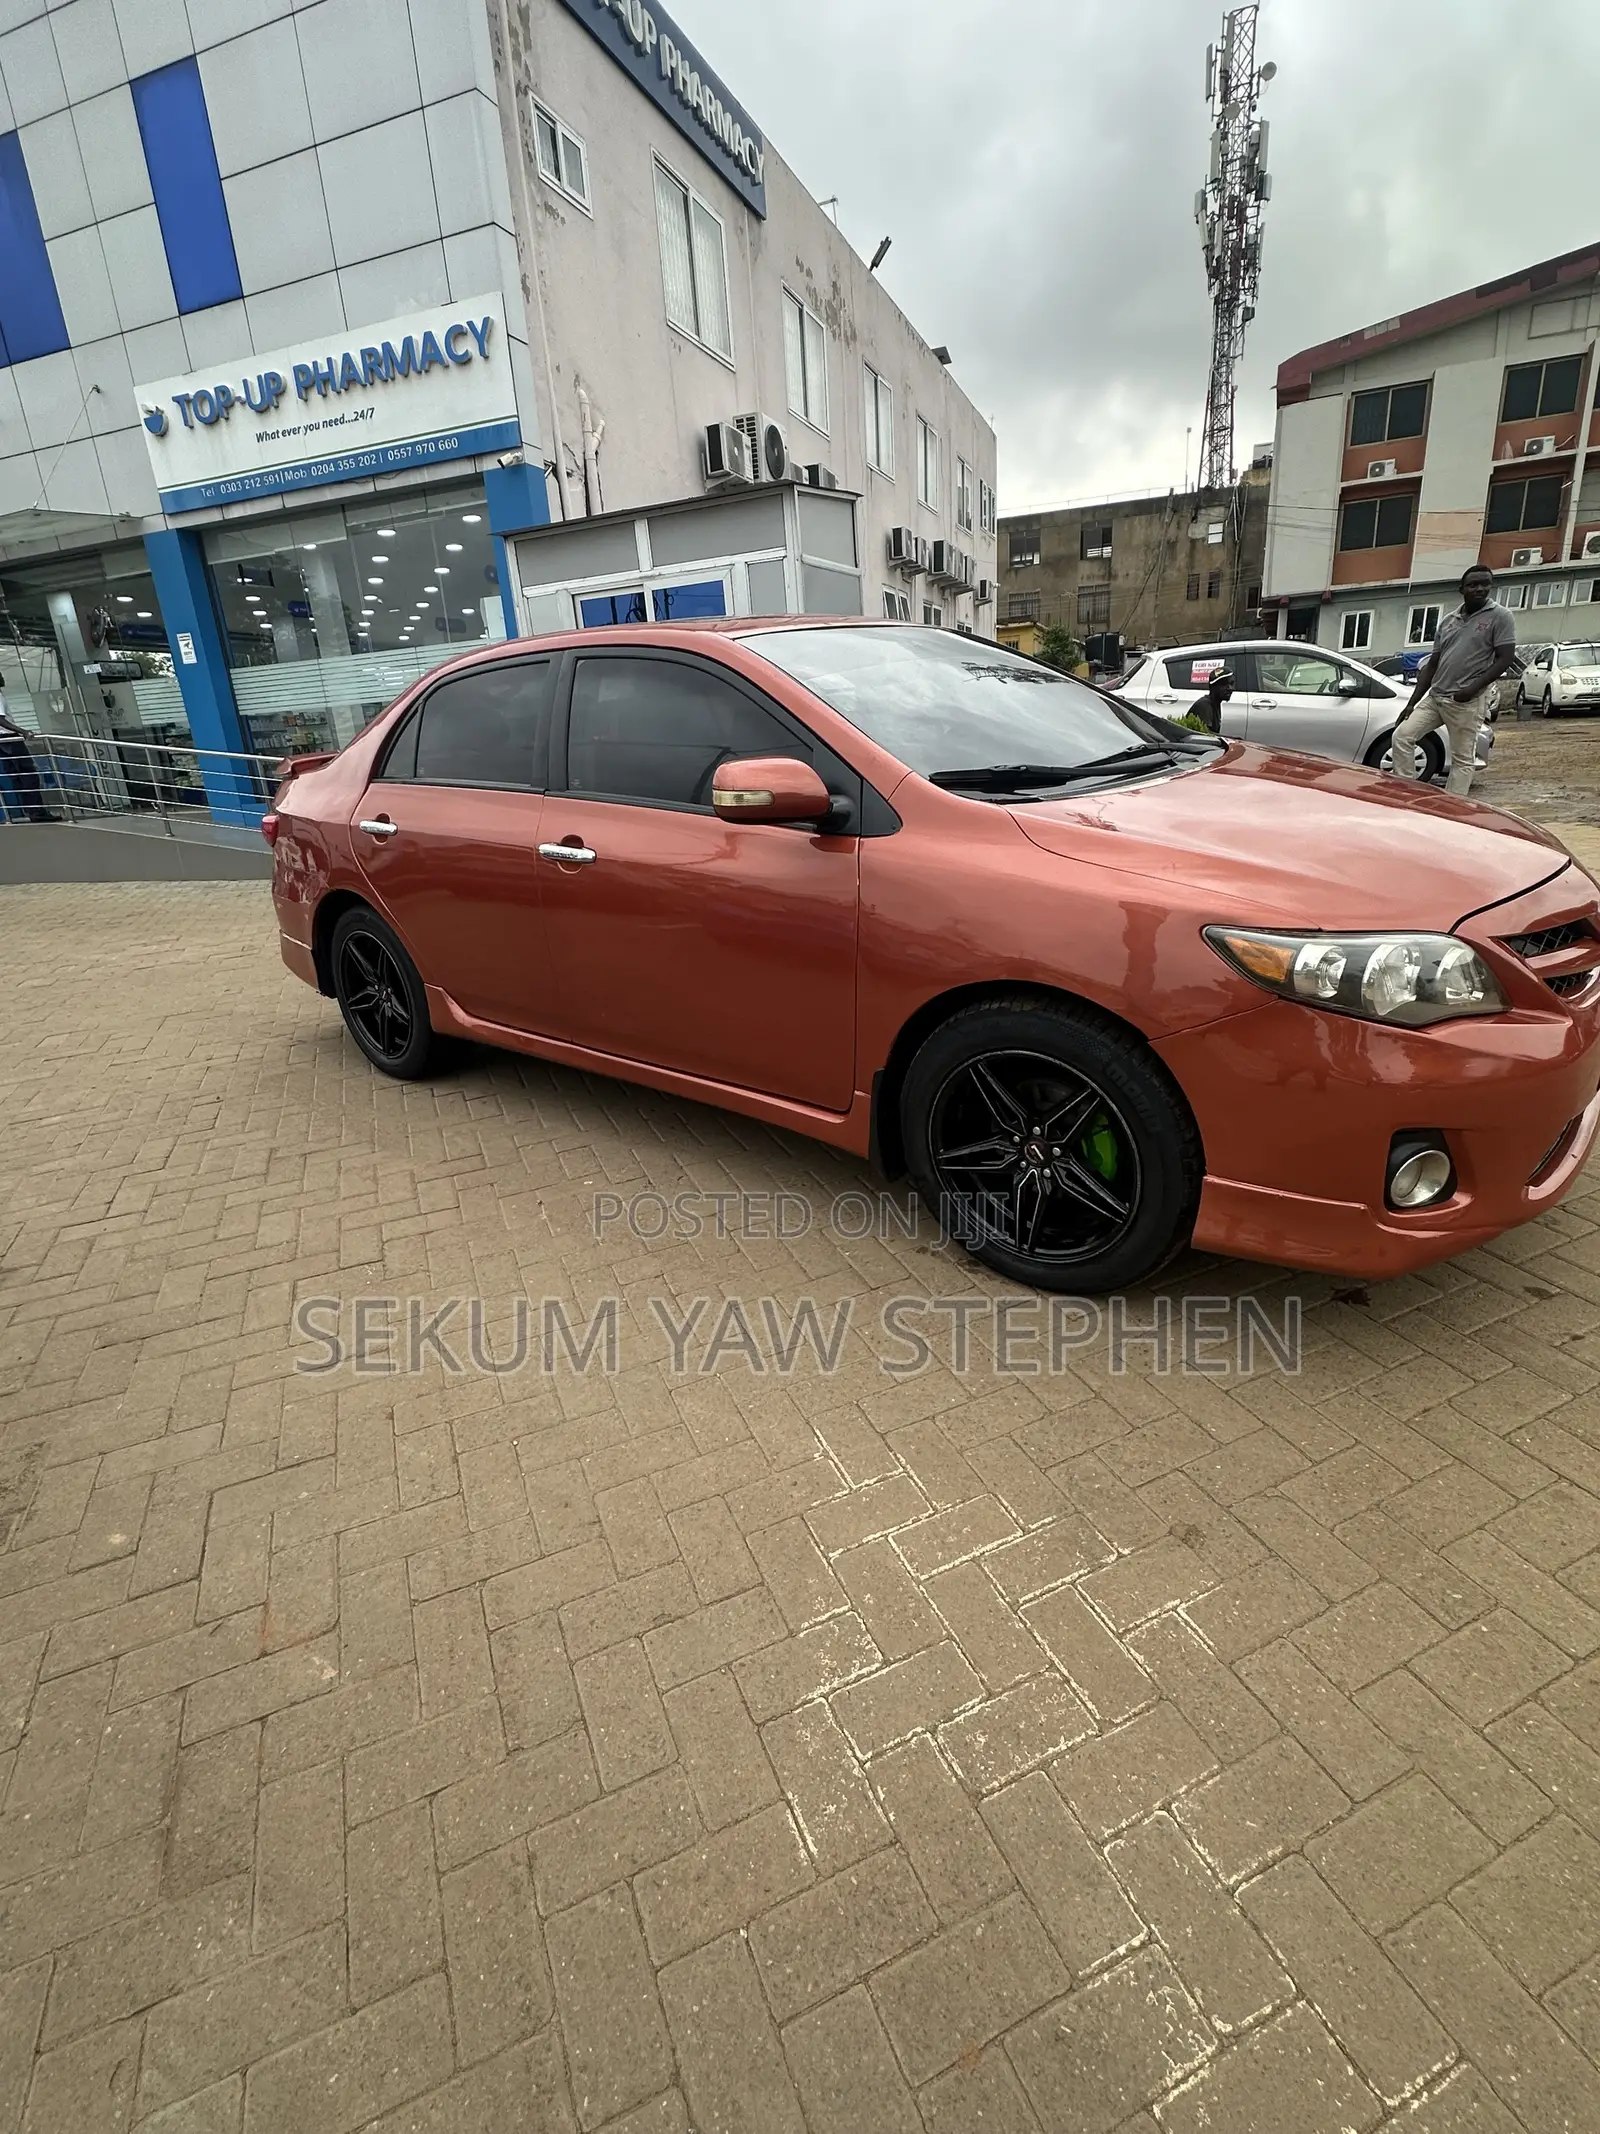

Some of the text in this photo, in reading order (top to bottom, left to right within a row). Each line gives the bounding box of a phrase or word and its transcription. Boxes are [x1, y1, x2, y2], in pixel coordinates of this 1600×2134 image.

[659, 33, 764, 186] PHARMACY
[172, 316, 494, 429] TOP-UP PHARMACY
[220, 482, 242, 495] 0303
[245, 477, 261, 490] 212
[311, 462, 335, 477] 0204
[338, 458, 356, 471] 355
[358, 454, 377, 467] 202
[387, 447, 412, 461] 0557
[415, 442, 435, 455] 970
[438, 437, 459, 450] 660
[256, 430, 280, 443] What
[281, 426, 301, 438] ever
[303, 422, 320, 436] you
